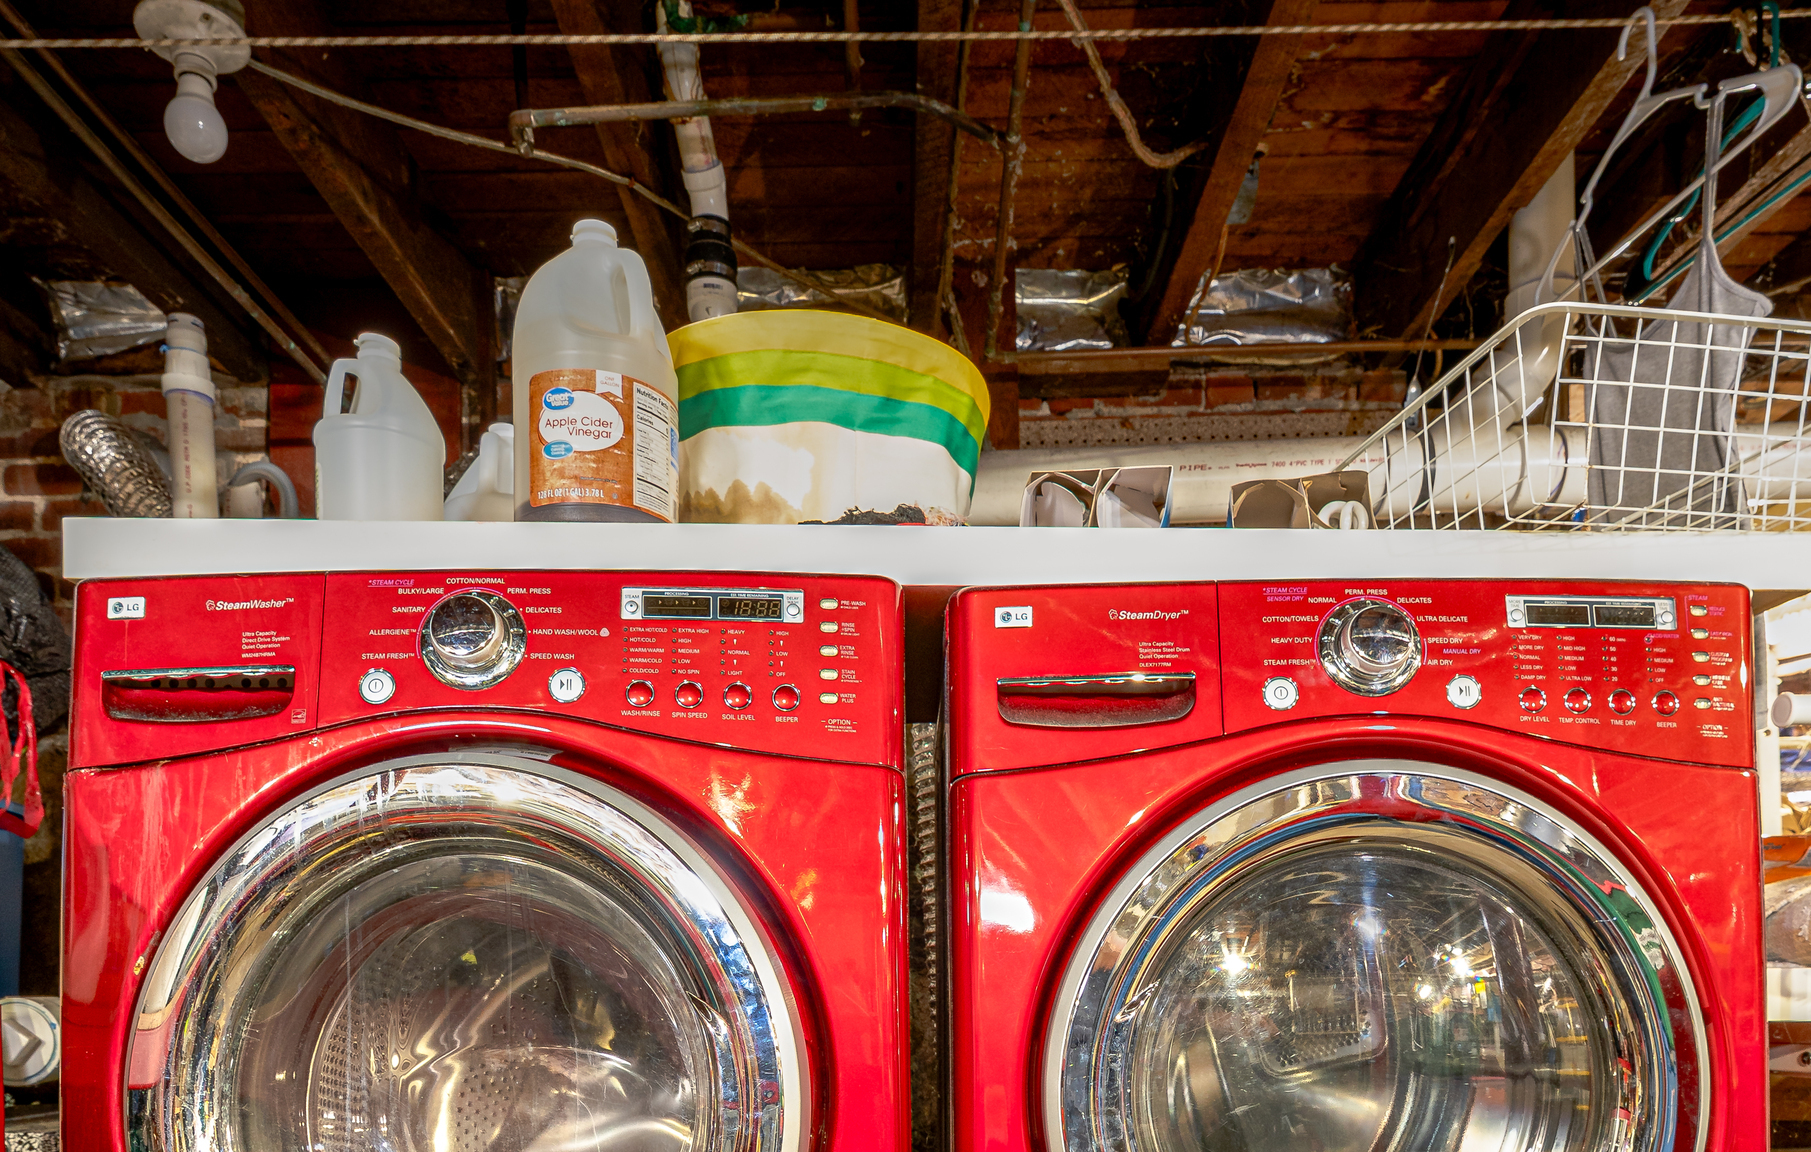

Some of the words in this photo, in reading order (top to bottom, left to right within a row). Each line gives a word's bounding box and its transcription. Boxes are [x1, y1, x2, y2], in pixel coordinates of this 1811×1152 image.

[600, 380, 619, 388] GALLON
[546, 392, 570, 403] Great
[637, 388, 657, 402] Nutrition
[545, 417, 577, 428] Apple
[581, 416, 613, 428] Cider
[567, 427, 612, 440] Vinegar
[538, 491, 547, 499] 128
[548, 489, 553, 498] FL
[555, 488, 562, 496] OZ
[570, 488, 584, 497] GAL)
[585, 489, 599, 497] 3.78
[601, 490, 604, 498] L
